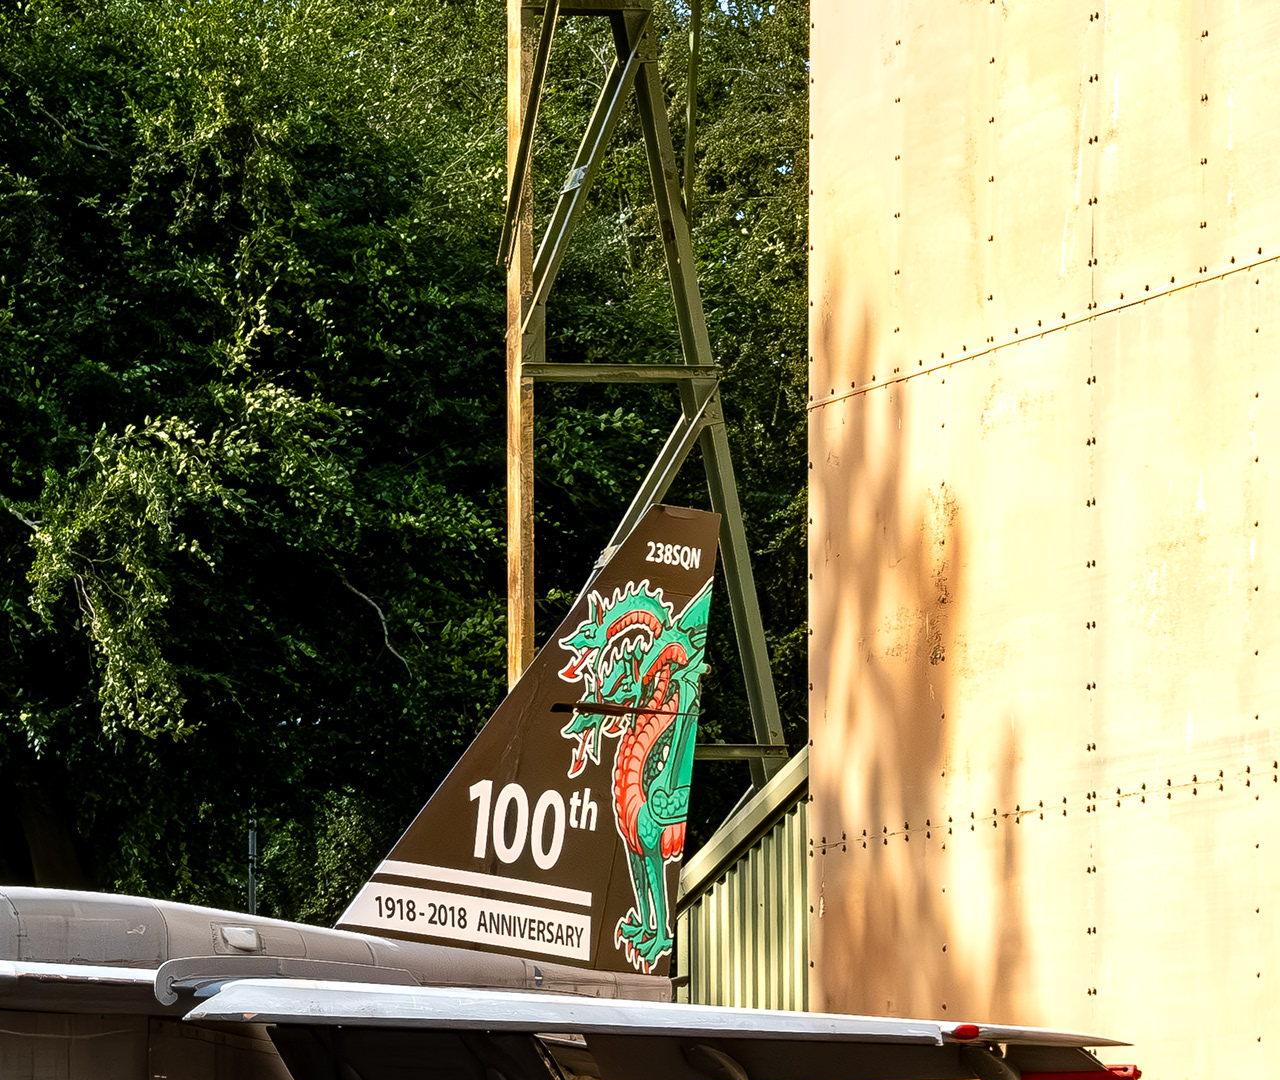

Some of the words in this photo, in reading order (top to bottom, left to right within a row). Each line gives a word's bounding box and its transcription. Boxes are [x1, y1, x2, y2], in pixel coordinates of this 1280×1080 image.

[645, 541, 702, 571] 238SQN
[469, 779, 598, 870] 100th
[476, 910, 584, 948] ANNIVERSARY
